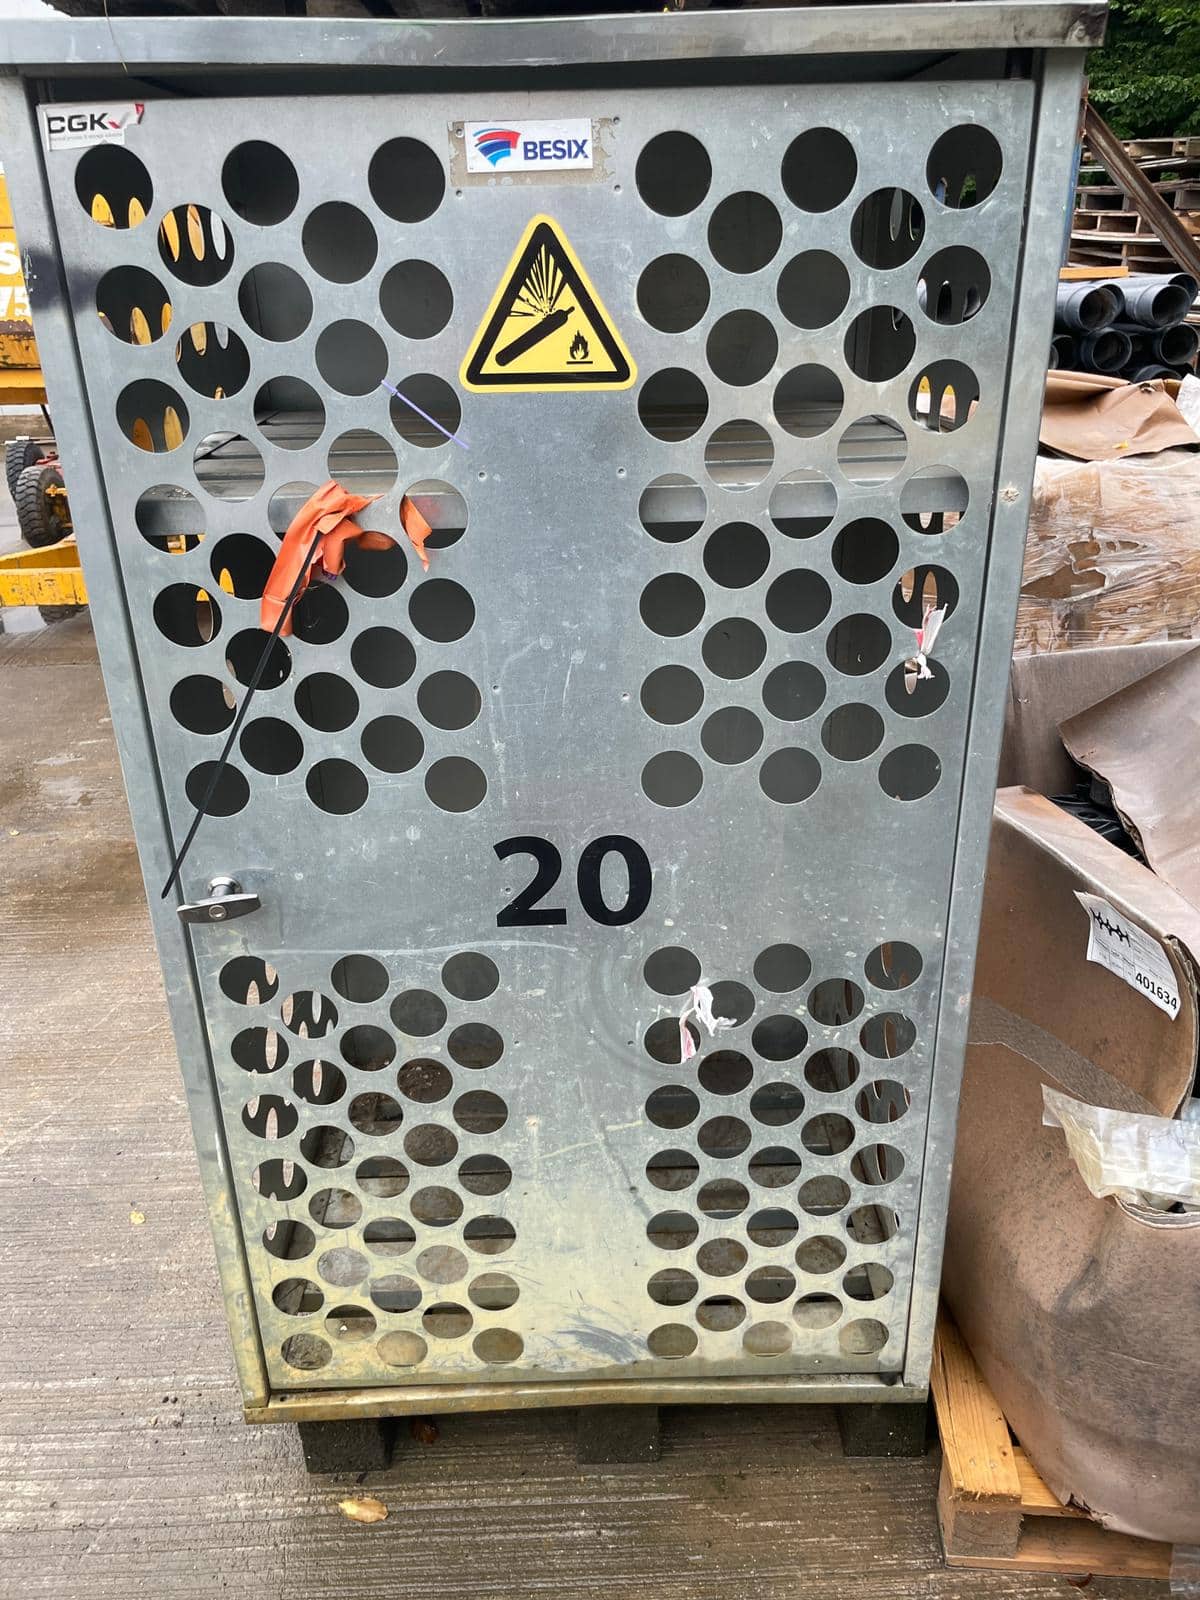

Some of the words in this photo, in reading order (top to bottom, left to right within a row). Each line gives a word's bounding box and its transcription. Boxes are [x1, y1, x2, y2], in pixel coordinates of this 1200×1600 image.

[47, 112, 109, 134] CGK
[523, 139, 589, 161] BESIX
[493, 834, 653, 927] 20
[1135, 973, 1178, 1011] 401634
